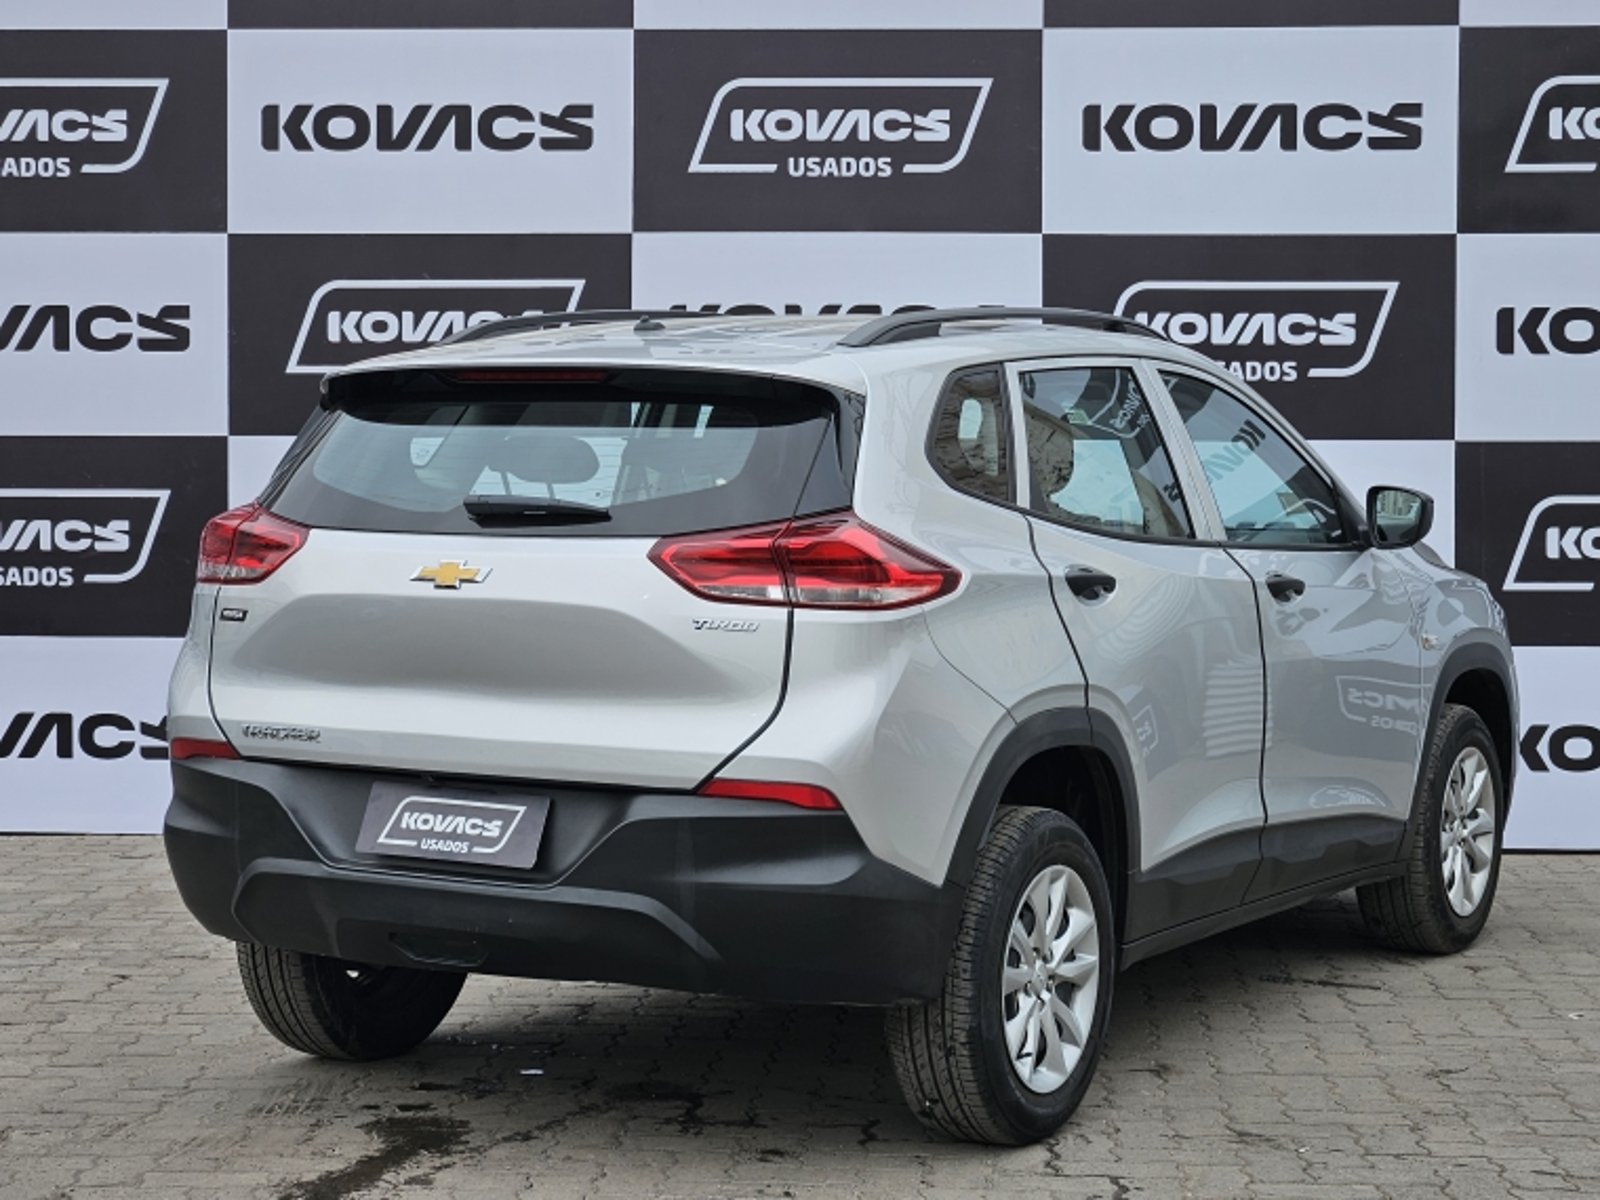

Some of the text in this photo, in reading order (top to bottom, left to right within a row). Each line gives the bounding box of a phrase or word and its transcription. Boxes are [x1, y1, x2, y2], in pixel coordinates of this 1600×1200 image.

[260, 104, 594, 152] KOVACS
[730, 108, 951, 142] KOVACS
[1082, 102, 1424, 152] KOVACS
[788, 157, 892, 178] USADOS
[327, 310, 543, 343] KOVA
[1218, 360, 1298, 382] ADOS
[0, 566, 74, 587] ADOS
[400, 811, 503, 838] KOVACS
[420, 837, 470, 854] USADOS
